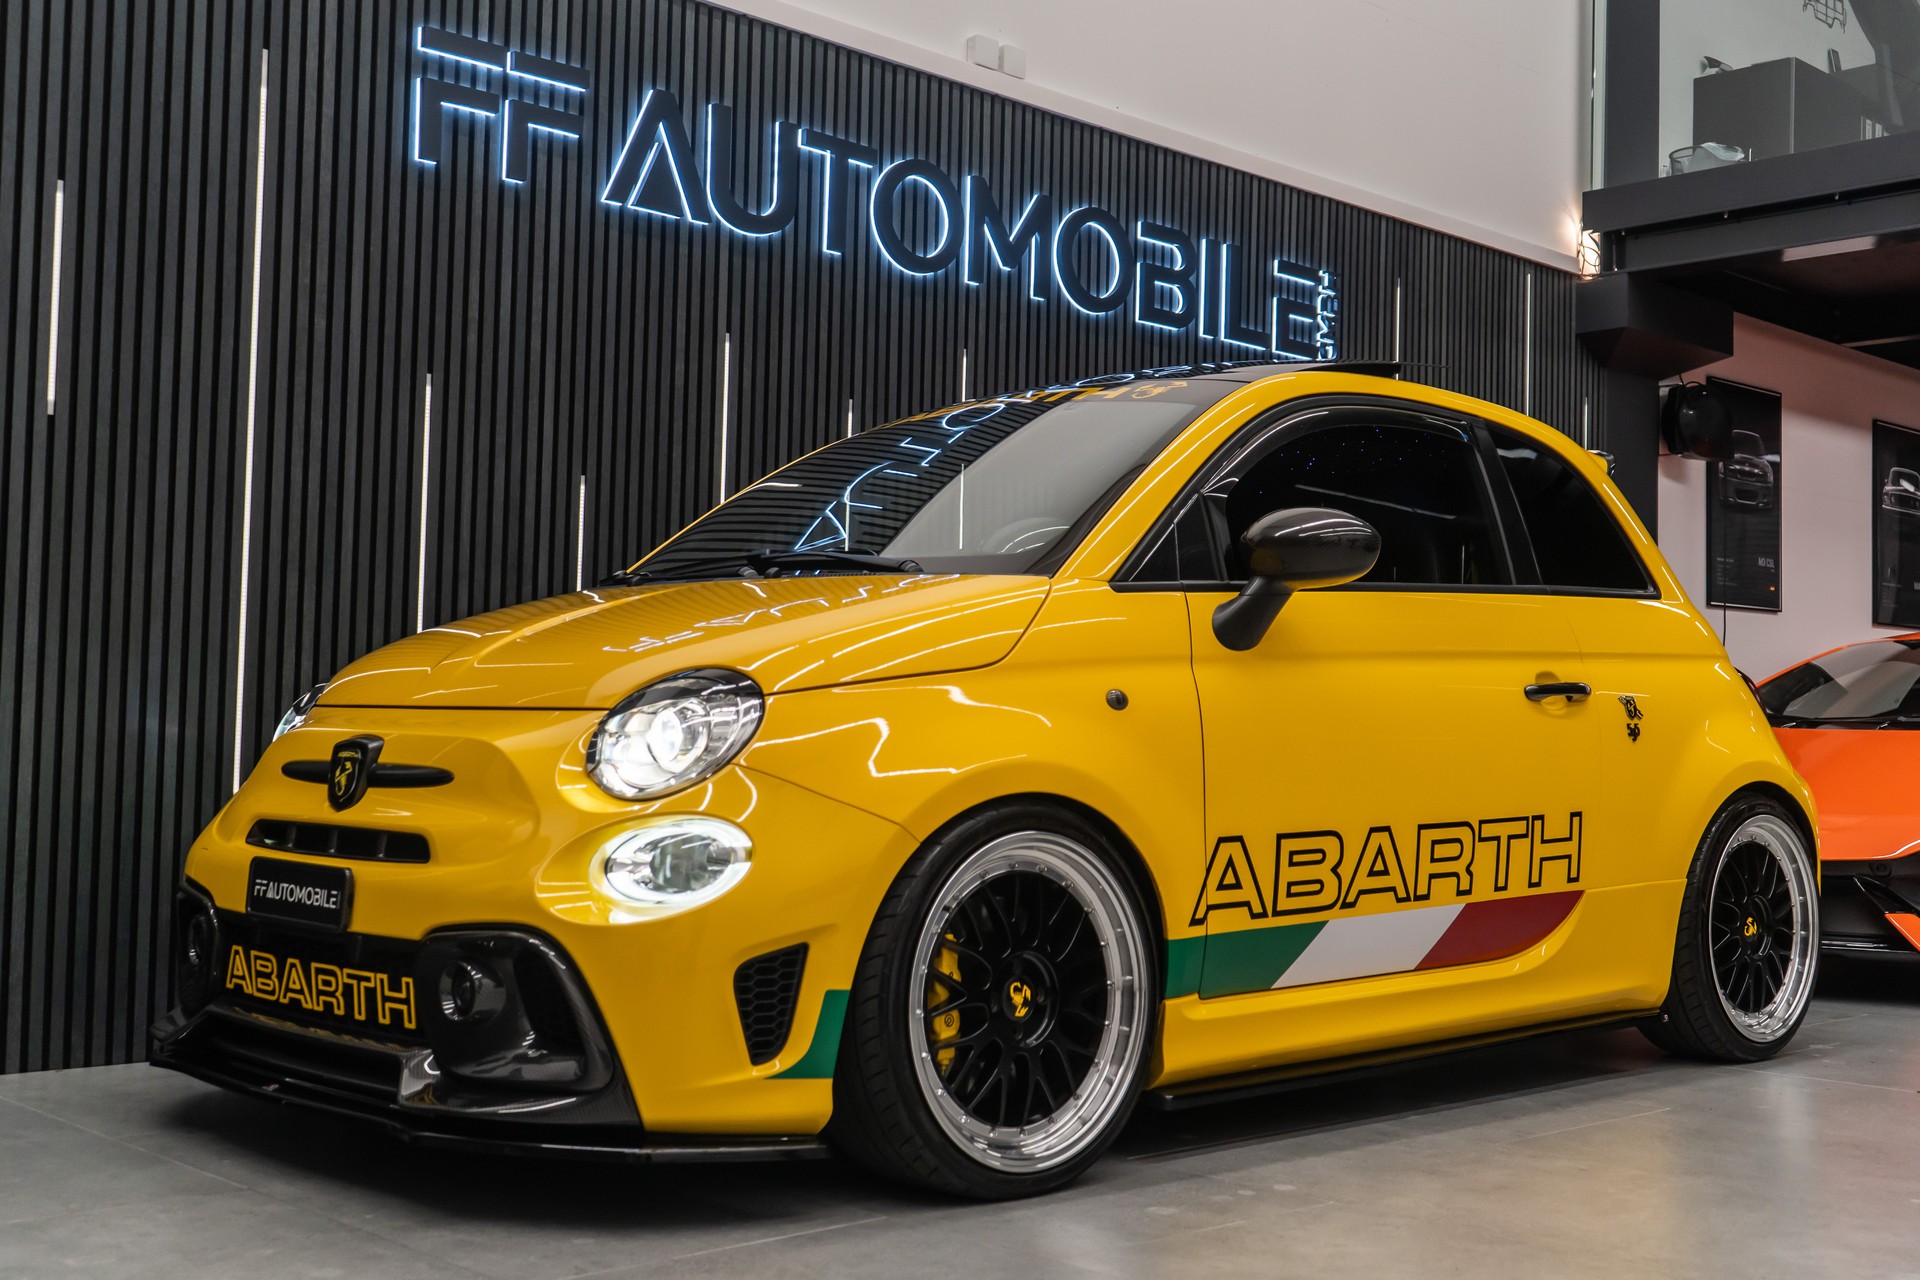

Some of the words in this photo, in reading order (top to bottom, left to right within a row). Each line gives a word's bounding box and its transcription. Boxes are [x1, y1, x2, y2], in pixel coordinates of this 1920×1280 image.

[601, 88, 1319, 361] AUTOMOBILE
[1189, 811, 1582, 927] ABARTH
[225, 945, 416, 1029] ABARTH
